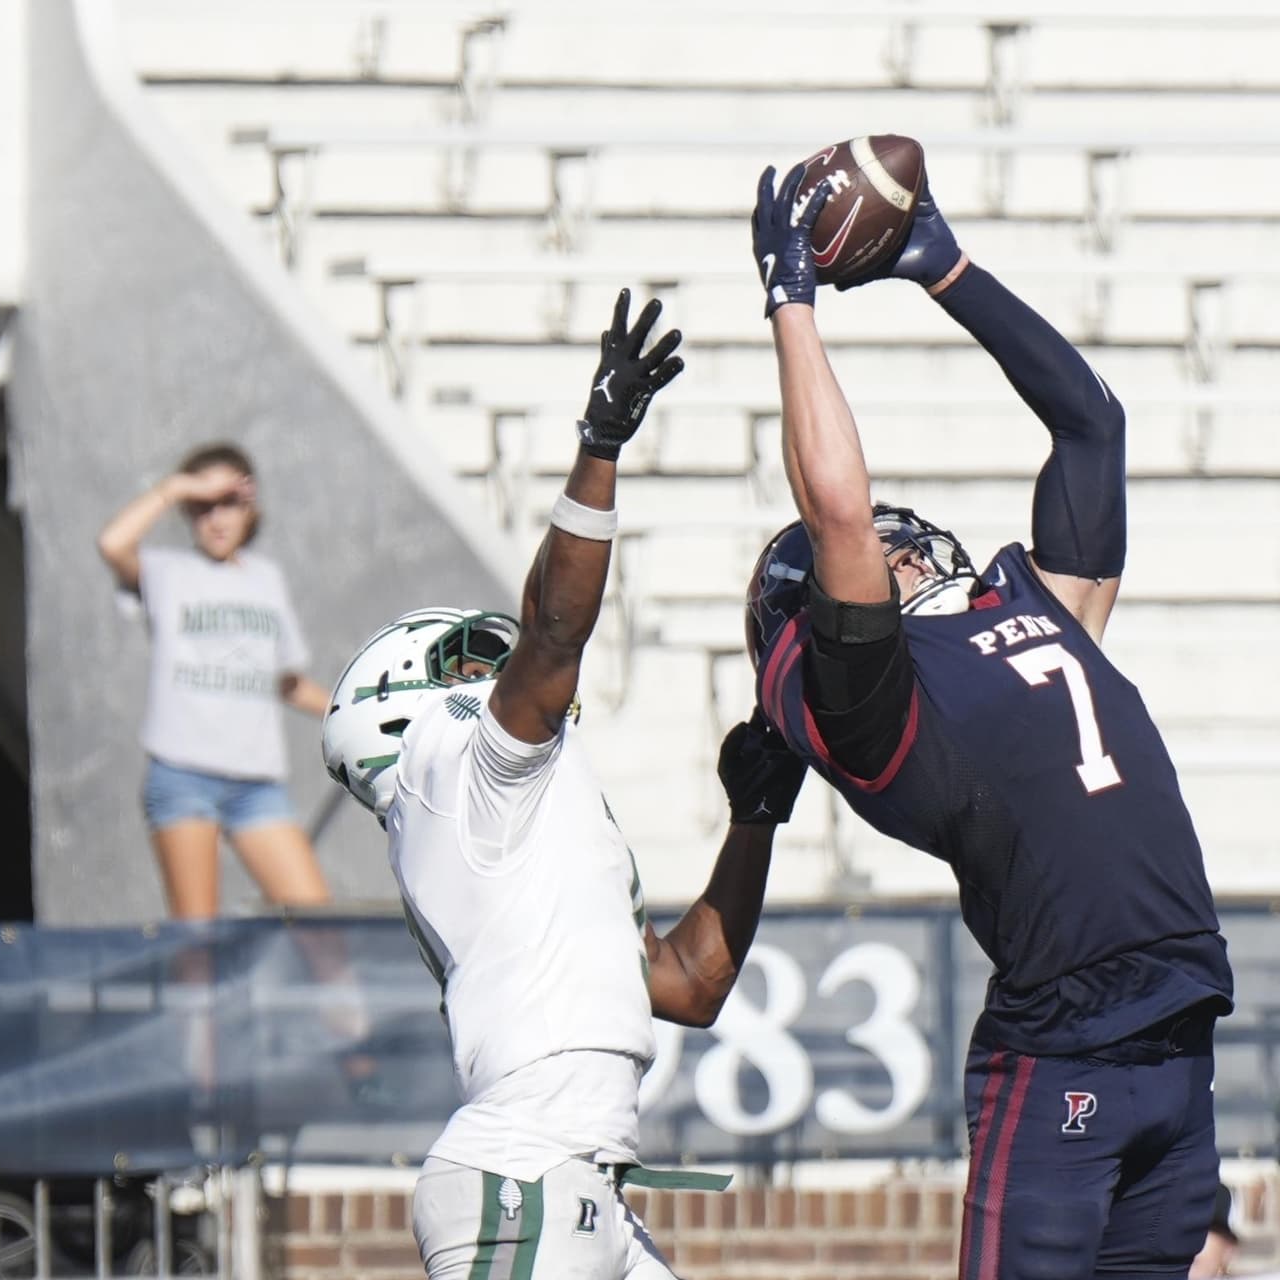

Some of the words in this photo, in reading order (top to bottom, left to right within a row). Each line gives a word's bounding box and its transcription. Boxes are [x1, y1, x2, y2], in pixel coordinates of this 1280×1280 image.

[969, 614, 1062, 655] PENN
[1004, 643, 1125, 795] 7
[1062, 1091, 1098, 1133] P
